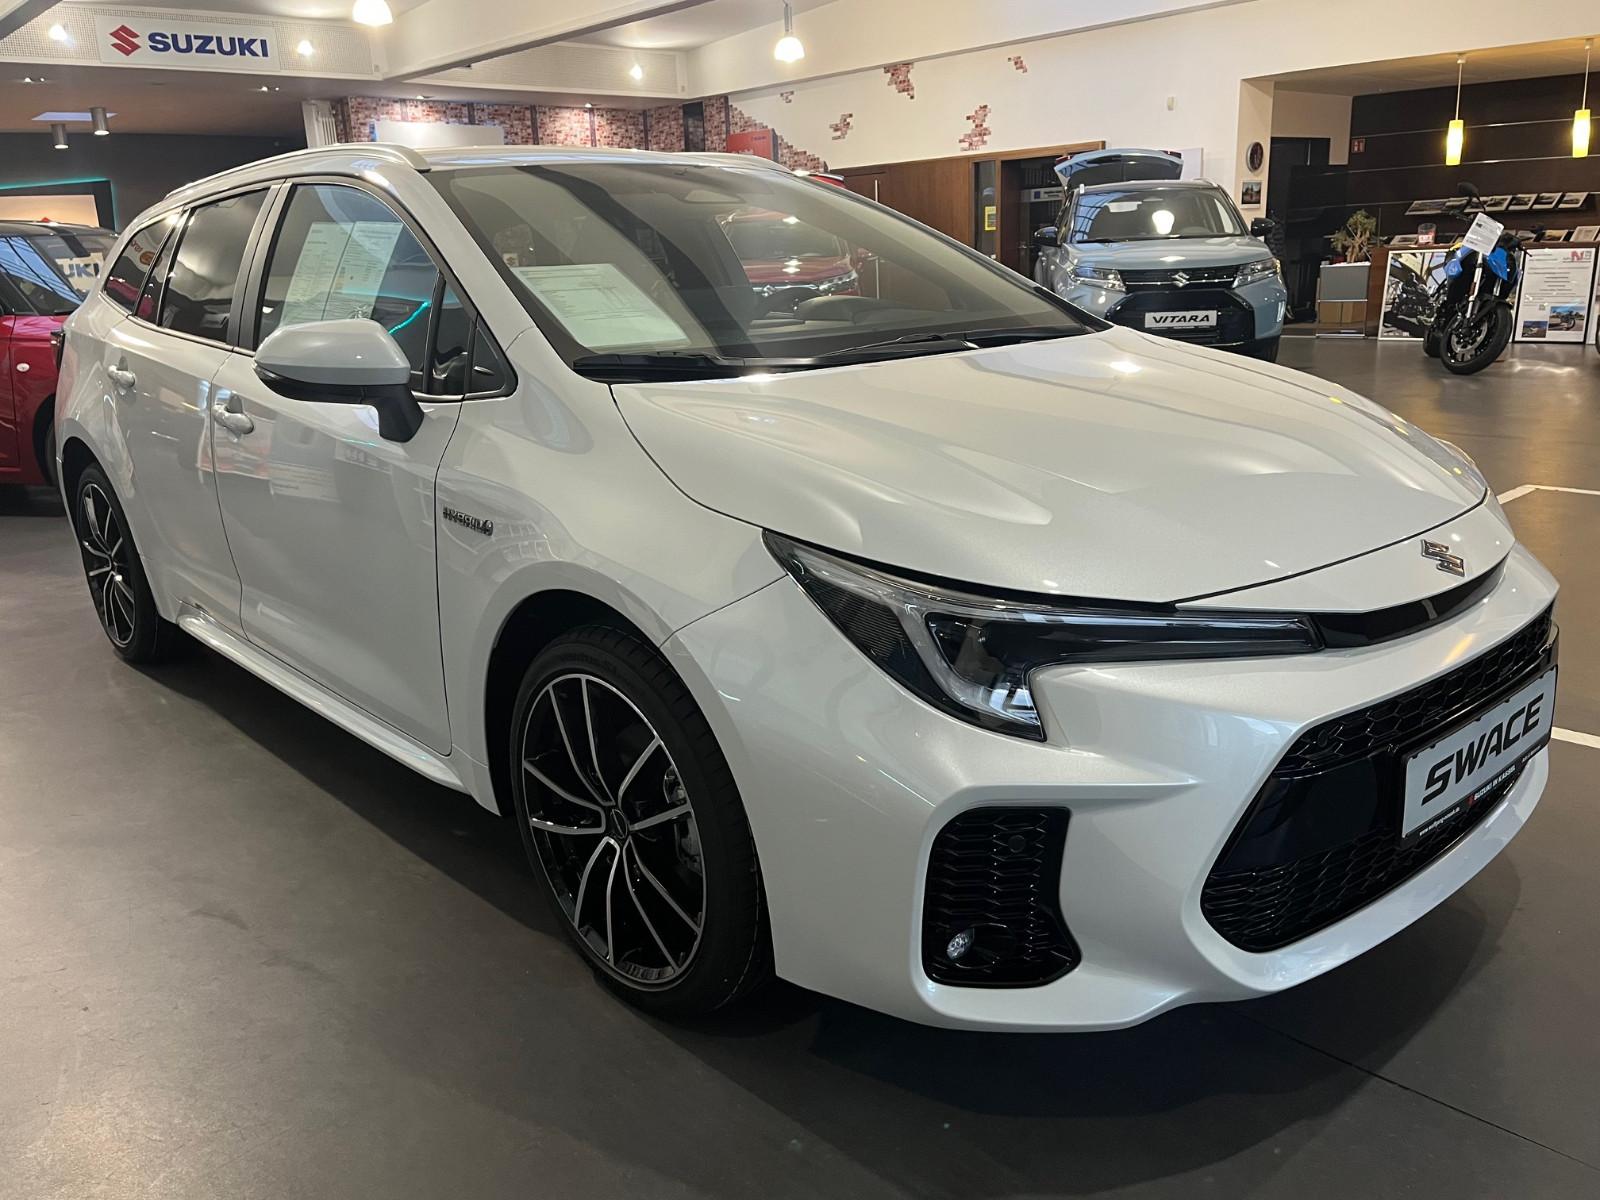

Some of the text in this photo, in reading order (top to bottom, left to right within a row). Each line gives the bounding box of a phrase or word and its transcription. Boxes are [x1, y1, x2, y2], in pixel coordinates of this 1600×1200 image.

[148, 32, 269, 57] SUZUKI
[1153, 315, 1209, 323] VITARA
[1421, 692, 1544, 806] SWACE
[1474, 782, 1492, 800] SUZUKI
